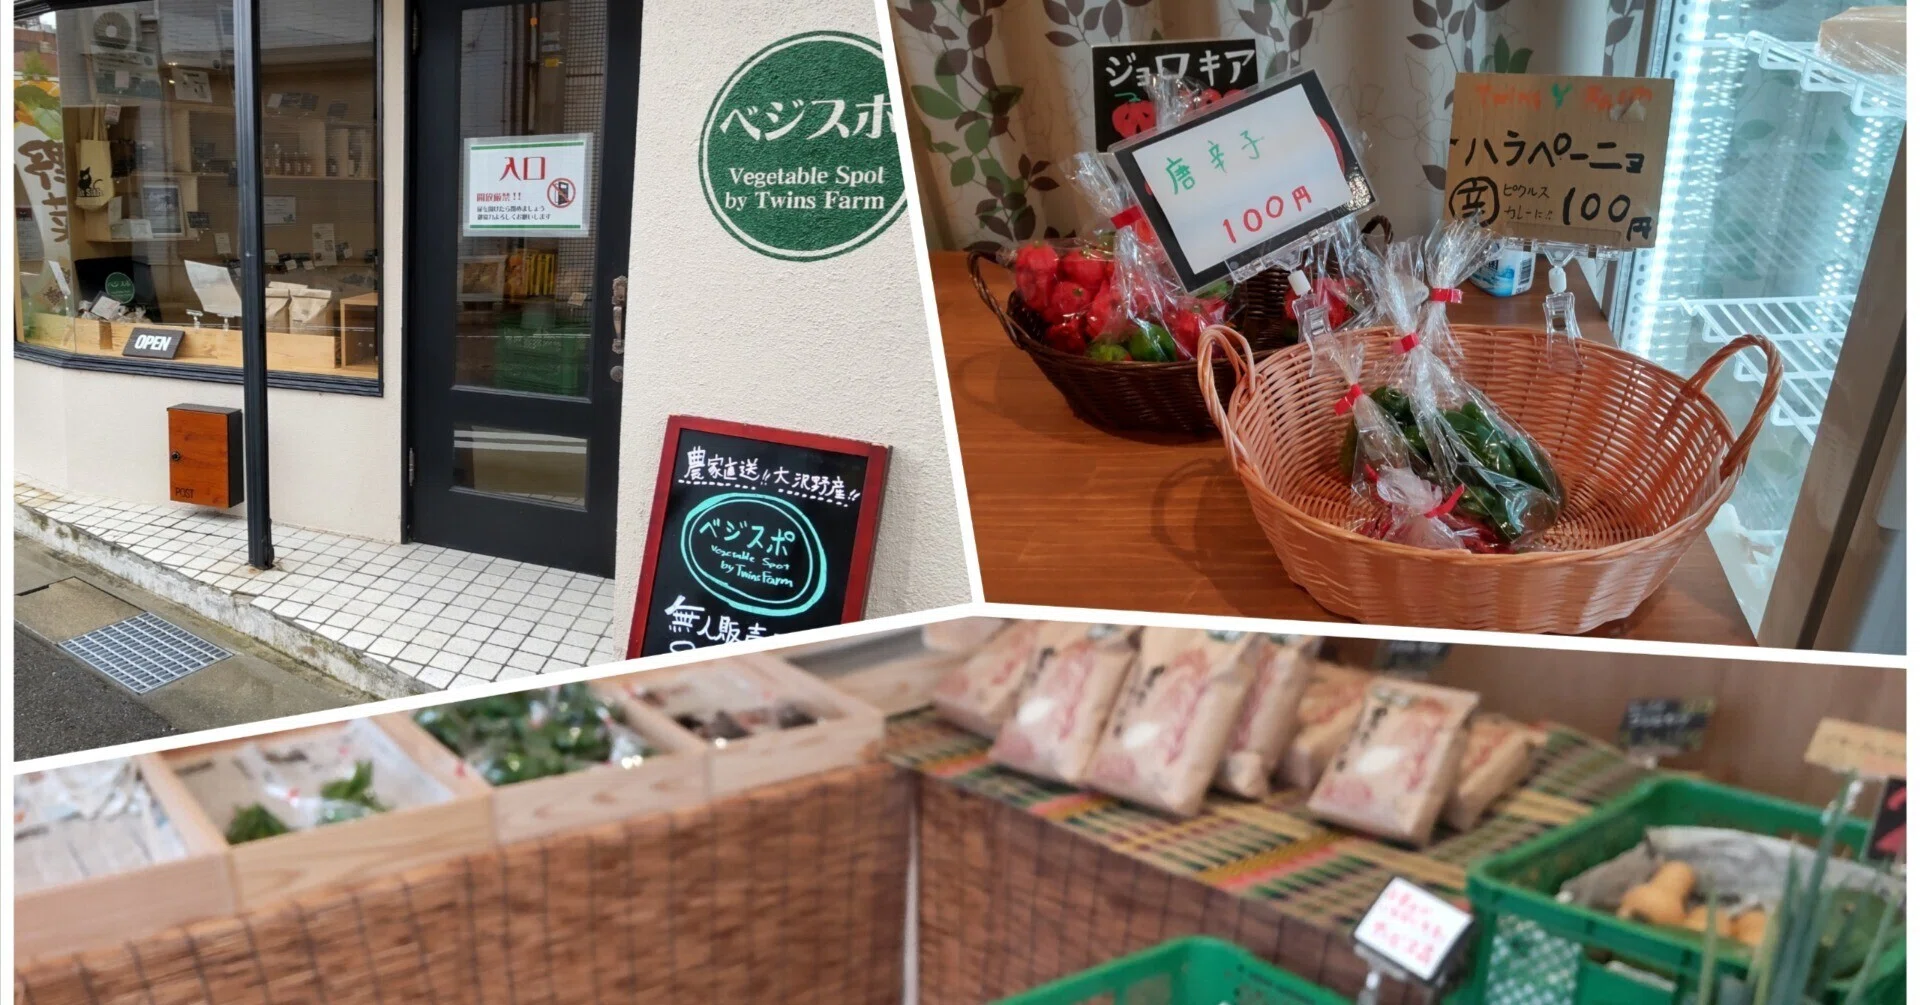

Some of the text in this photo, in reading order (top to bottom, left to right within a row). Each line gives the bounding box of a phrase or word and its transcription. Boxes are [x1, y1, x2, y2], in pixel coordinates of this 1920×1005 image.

[1164, 130, 1265, 195] 唐辛子
[1464, 130, 1645, 174] ハラペーニョ
[499, 156, 546, 181] 入口
[728, 165, 885, 188] Vegetable Spot
[725, 190, 885, 211] by Twins Farm
[1502, 183, 1550, 199] ピクルス
[1222, 185, 1312, 244] 100円
[134, 334, 172, 351] OPEN
[684, 446, 771, 486] 農家直送!!
[175, 487, 194, 499] POST
[699, 518, 796, 556] ベジスポ
[720, 560, 735, 574] by
[664, 594, 781, 644] 無人販売
